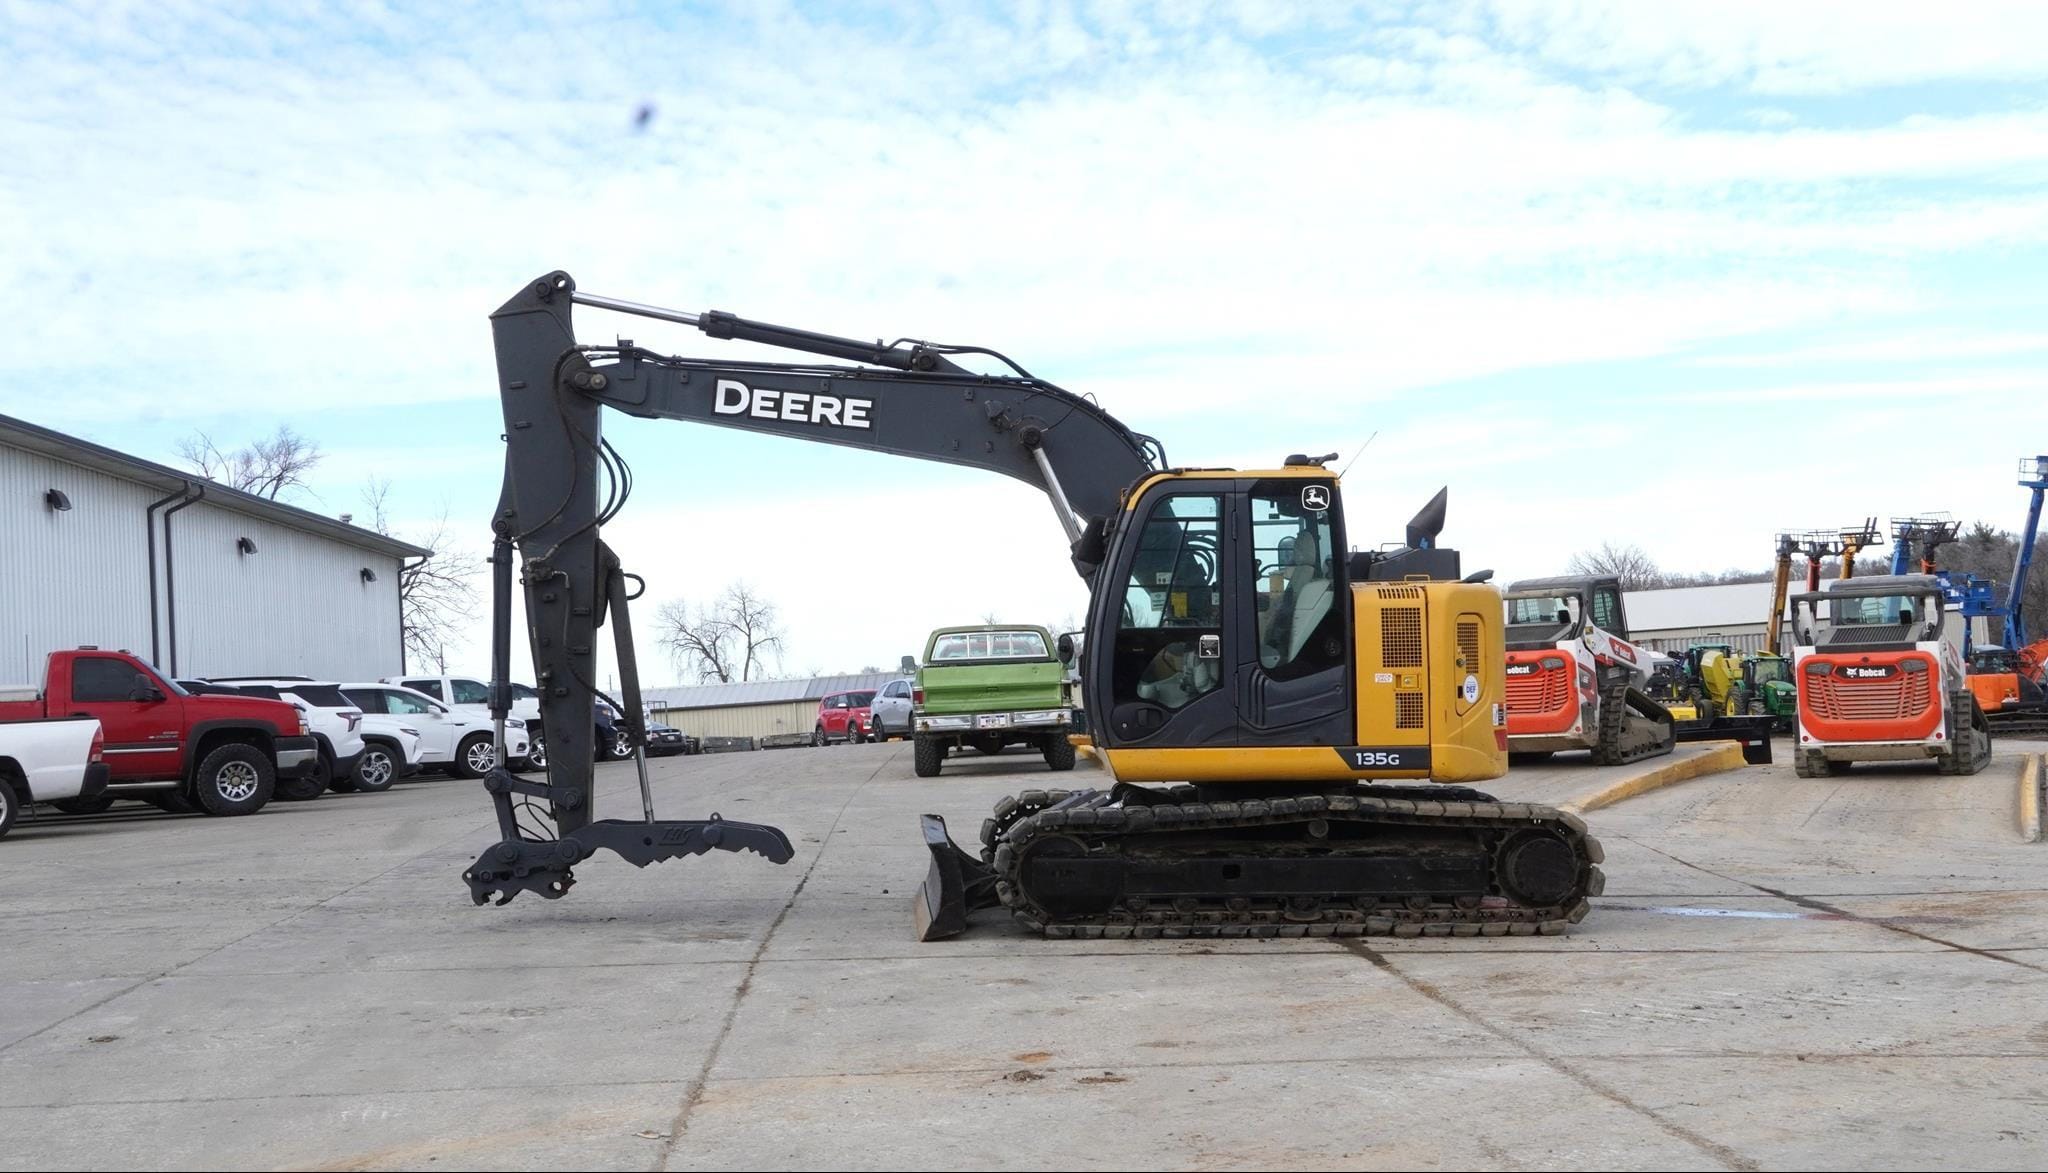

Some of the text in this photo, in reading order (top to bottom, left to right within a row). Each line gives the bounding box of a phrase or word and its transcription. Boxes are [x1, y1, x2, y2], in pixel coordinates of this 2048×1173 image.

[714, 379, 872, 429] DEERE
[1858, 668, 1886, 677] Bobcat
[1355, 752, 1400, 766] 135G
